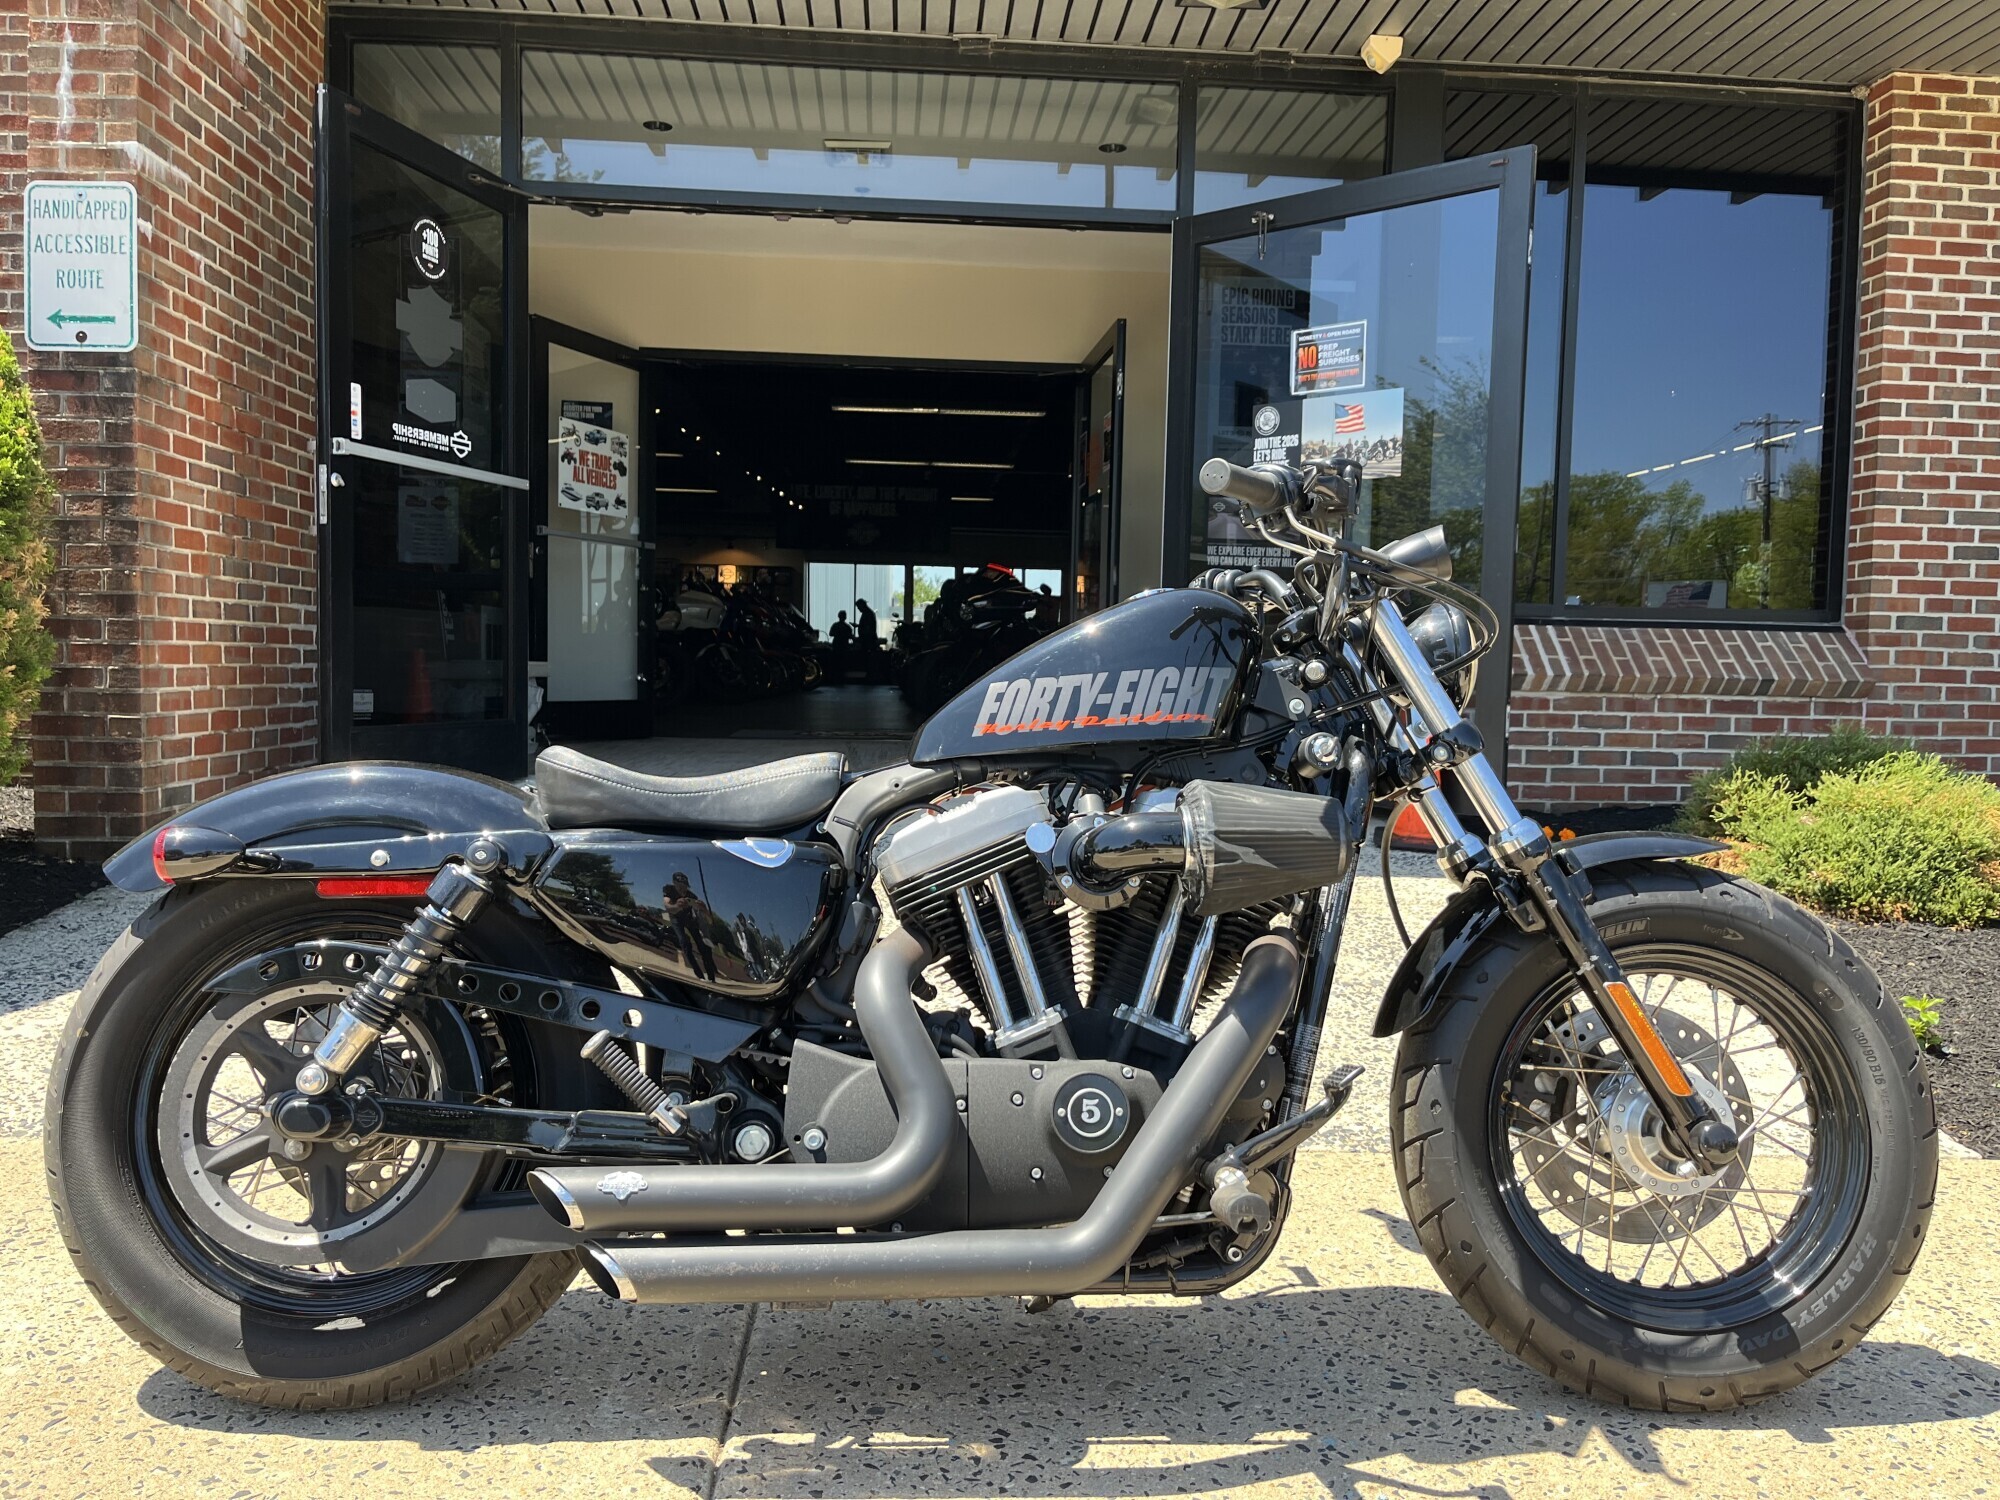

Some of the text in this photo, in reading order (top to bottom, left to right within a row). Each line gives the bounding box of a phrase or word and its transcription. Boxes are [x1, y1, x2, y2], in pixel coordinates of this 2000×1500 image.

[33, 199, 127, 221] HANDICAPPED
[34, 234, 127, 255] ACCESSIBLE
[56, 269, 104, 289] ROUTE
[1222, 288, 1294, 307] EPIC RIDING
[1221, 307, 1276, 325] SEASONS
[1221, 326, 1291, 344] START HERE
[1298, 343, 1339, 369] NO PREP
[1318, 348, 1351, 359] FREIGHT
[1318, 354, 1360, 366] SURPRISES
[1253, 437, 1268, 450] JOIN
[1269, 436, 1282, 448] THE
[579, 449, 612, 472] WE TRADE
[1253, 448, 1286, 462] LET'S RIDE
[573, 465, 617, 491] ALL VEHICLES
[1207, 545, 1217, 555] WE
[1218, 546, 1245, 556] EXPLORE
[1246, 547, 1265, 556] EVERY
[1266, 547, 1281, 557] INCH
[1207, 556, 1219, 565] YOU
[1220, 556, 1233, 566] CAN
[1234, 556, 1261, 566] EXPLORE
[1262, 557, 1281, 567] EVERY
[972, 666, 1232, 738] FORTY-EIGHT
[974, 710, 1216, 735] Harley-Davidson
[1081, 1098, 1101, 1124] 5
